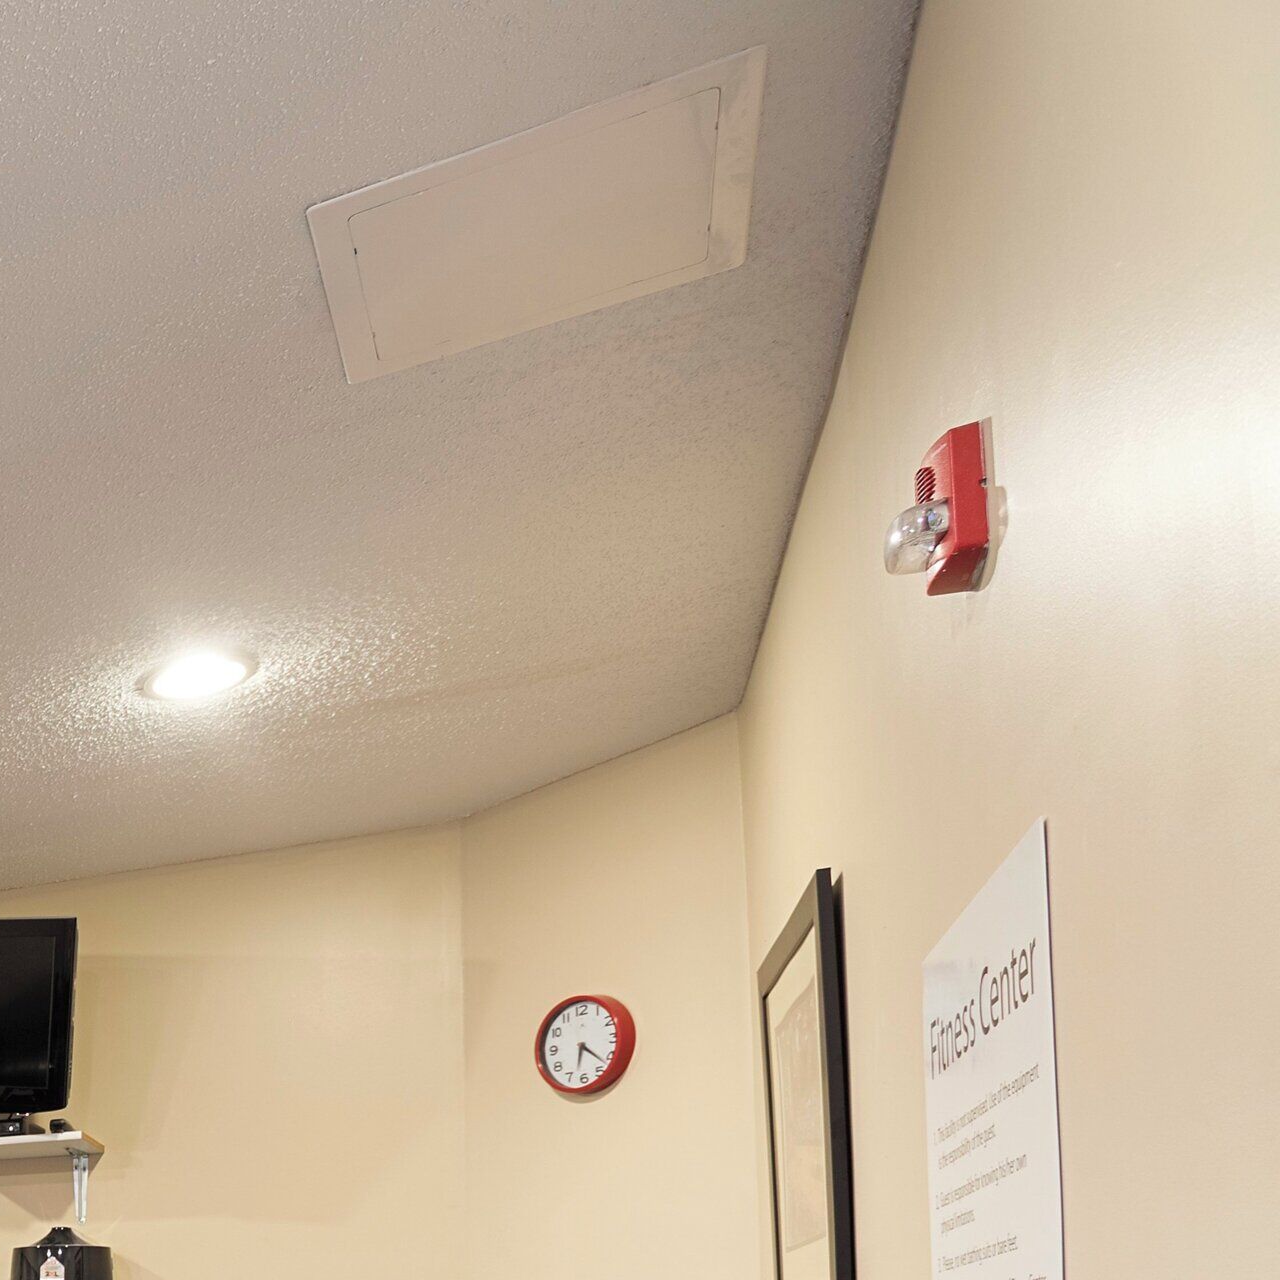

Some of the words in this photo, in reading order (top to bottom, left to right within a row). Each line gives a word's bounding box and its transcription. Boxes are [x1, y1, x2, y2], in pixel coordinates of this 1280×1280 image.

[575, 1004, 588, 1016] 12
[596, 1005, 600, 1016] 1
[930, 996, 976, 1081] Fitness
[978, 937, 1037, 1037] Center
[562, 1013, 570, 1024] 11
[605, 1016, 615, 1027] 2
[552, 1027, 562, 1038] 10
[609, 1032, 617, 1044] 3
[549, 1045, 559, 1056] 9
[553, 1061, 563, 1072] 8
[595, 1066, 605, 1078] 5
[565, 1072, 574, 1082] 7
[580, 1073, 589, 1084] 6
[1011, 1061, 1039, 1099] equipment
[981, 1165, 998, 1192] knowing
